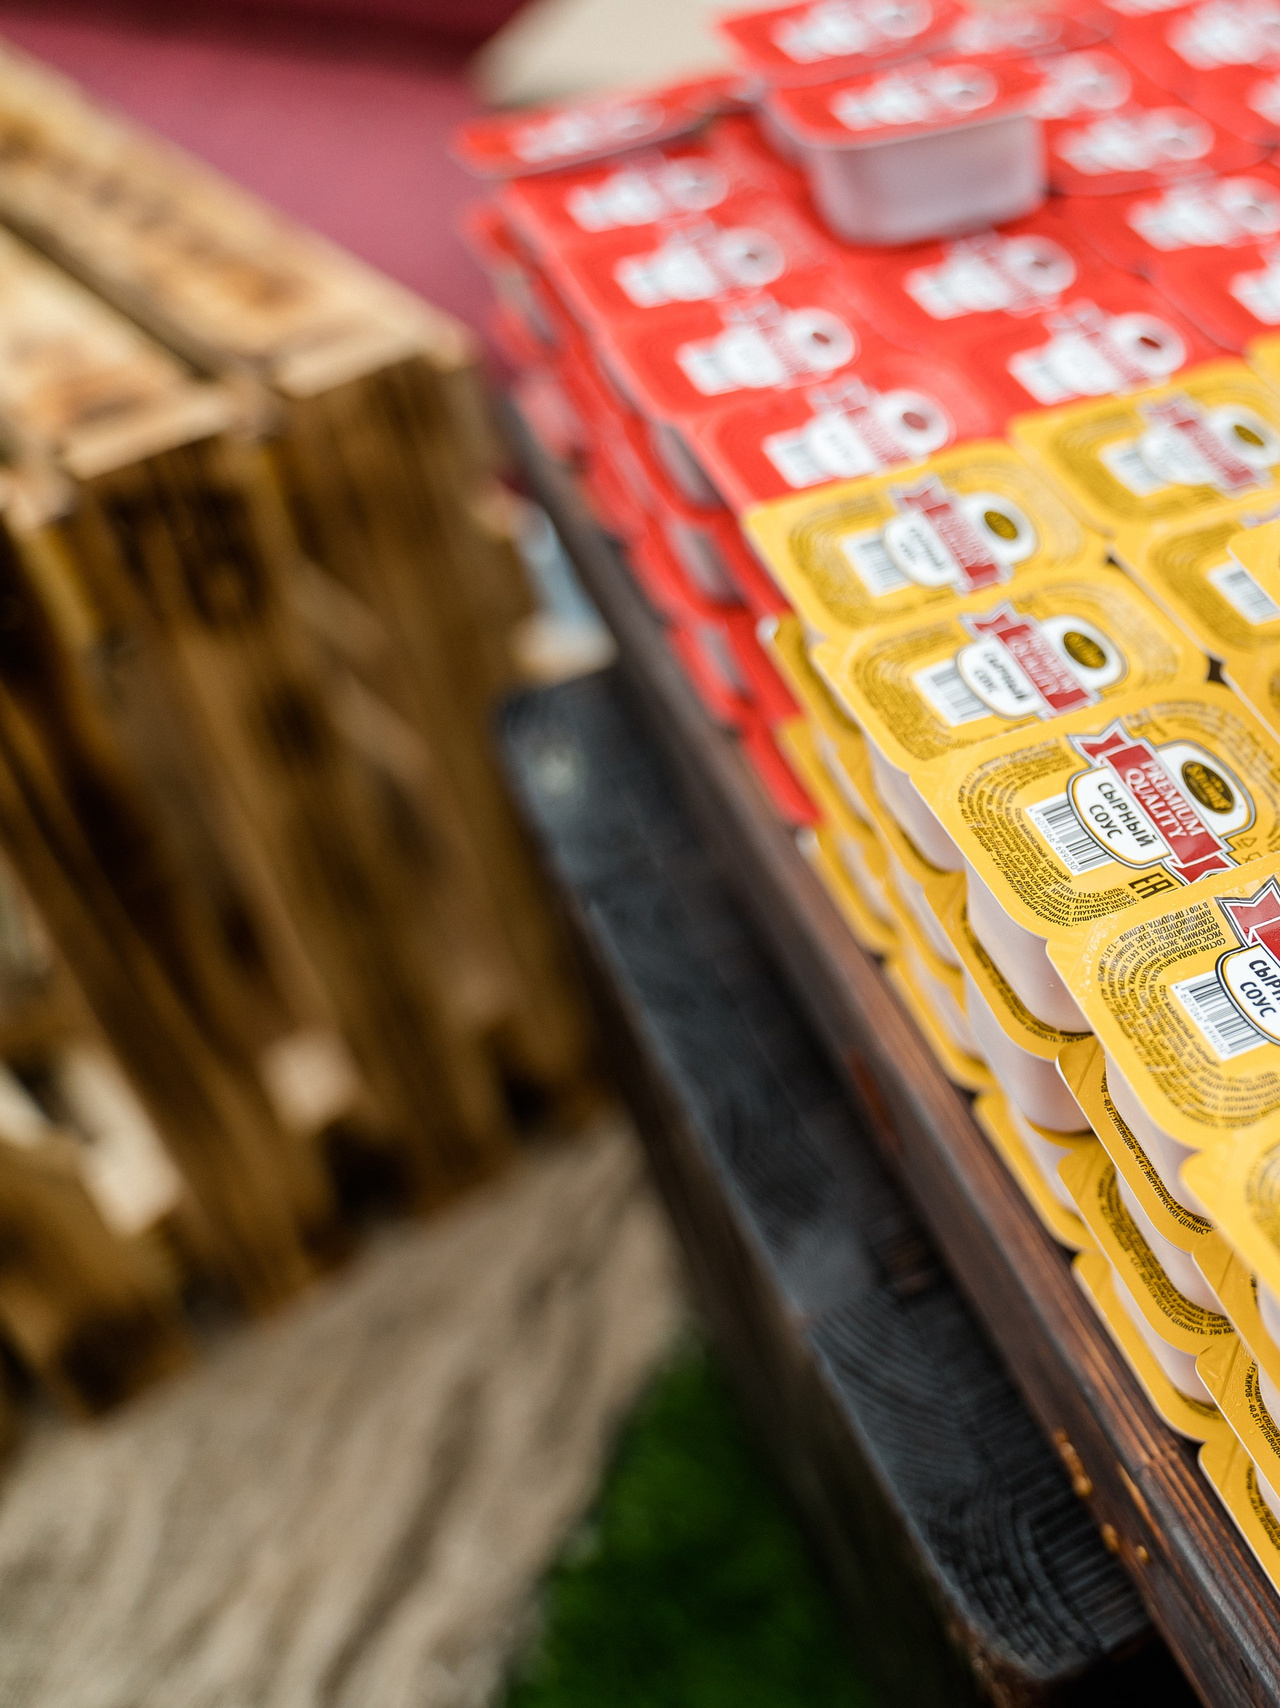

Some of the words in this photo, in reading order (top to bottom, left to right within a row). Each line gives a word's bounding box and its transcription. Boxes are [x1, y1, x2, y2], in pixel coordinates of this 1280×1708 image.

[1085, 802, 1124, 839] СОУС
[1093, 780, 1158, 848] СЫРНЫЙ
[1120, 765, 1190, 841] QUALITY
[1137, 758, 1207, 837] PREMIUM
[1235, 978, 1278, 1019] СОУС
